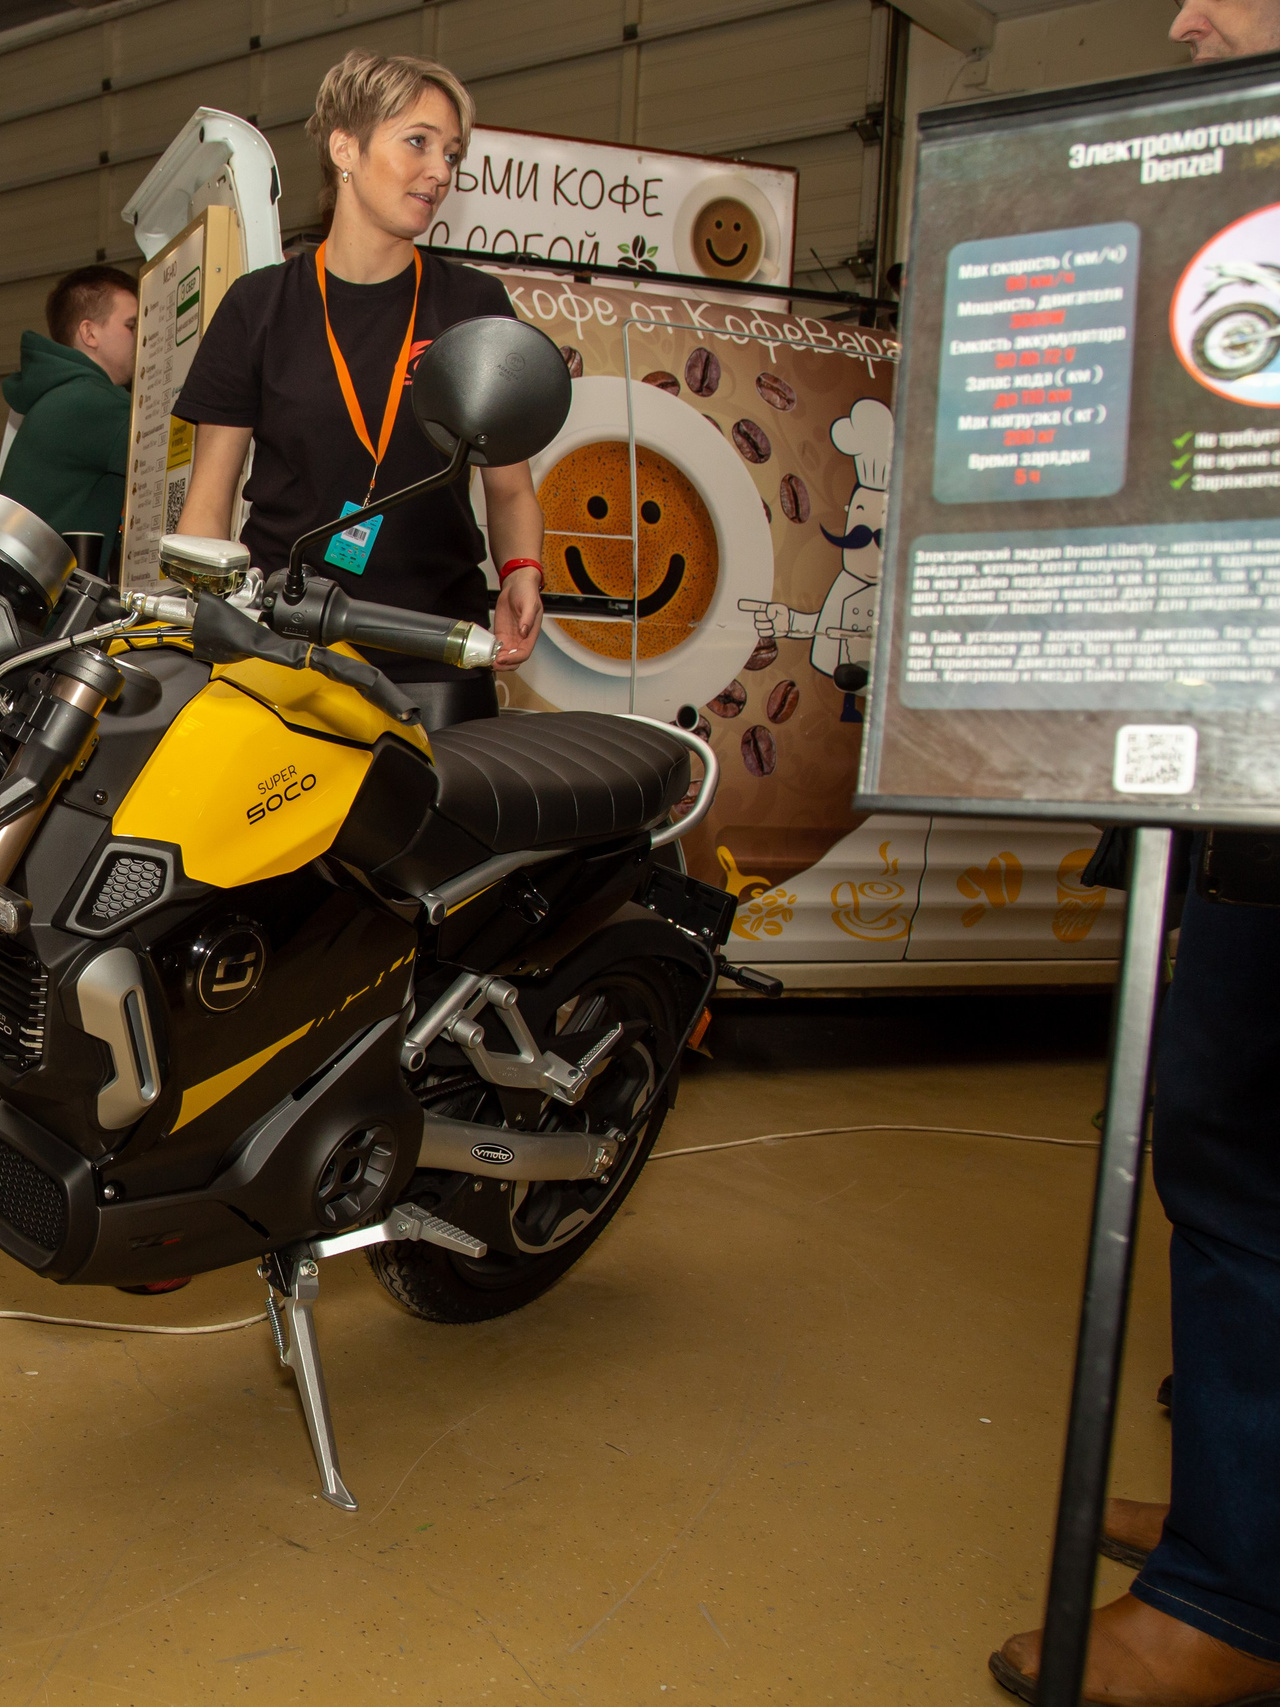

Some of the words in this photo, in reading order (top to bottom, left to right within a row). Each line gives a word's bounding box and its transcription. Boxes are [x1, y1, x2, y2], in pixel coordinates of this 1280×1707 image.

[1140, 147, 1224, 184] Denzel
[554, 164, 664, 217] КОФЕ
[631, 302, 673, 334] от
[965, 374, 1011, 392] Запас
[257, 765, 297, 795] SUPER
[246, 774, 317, 825] SOCO
